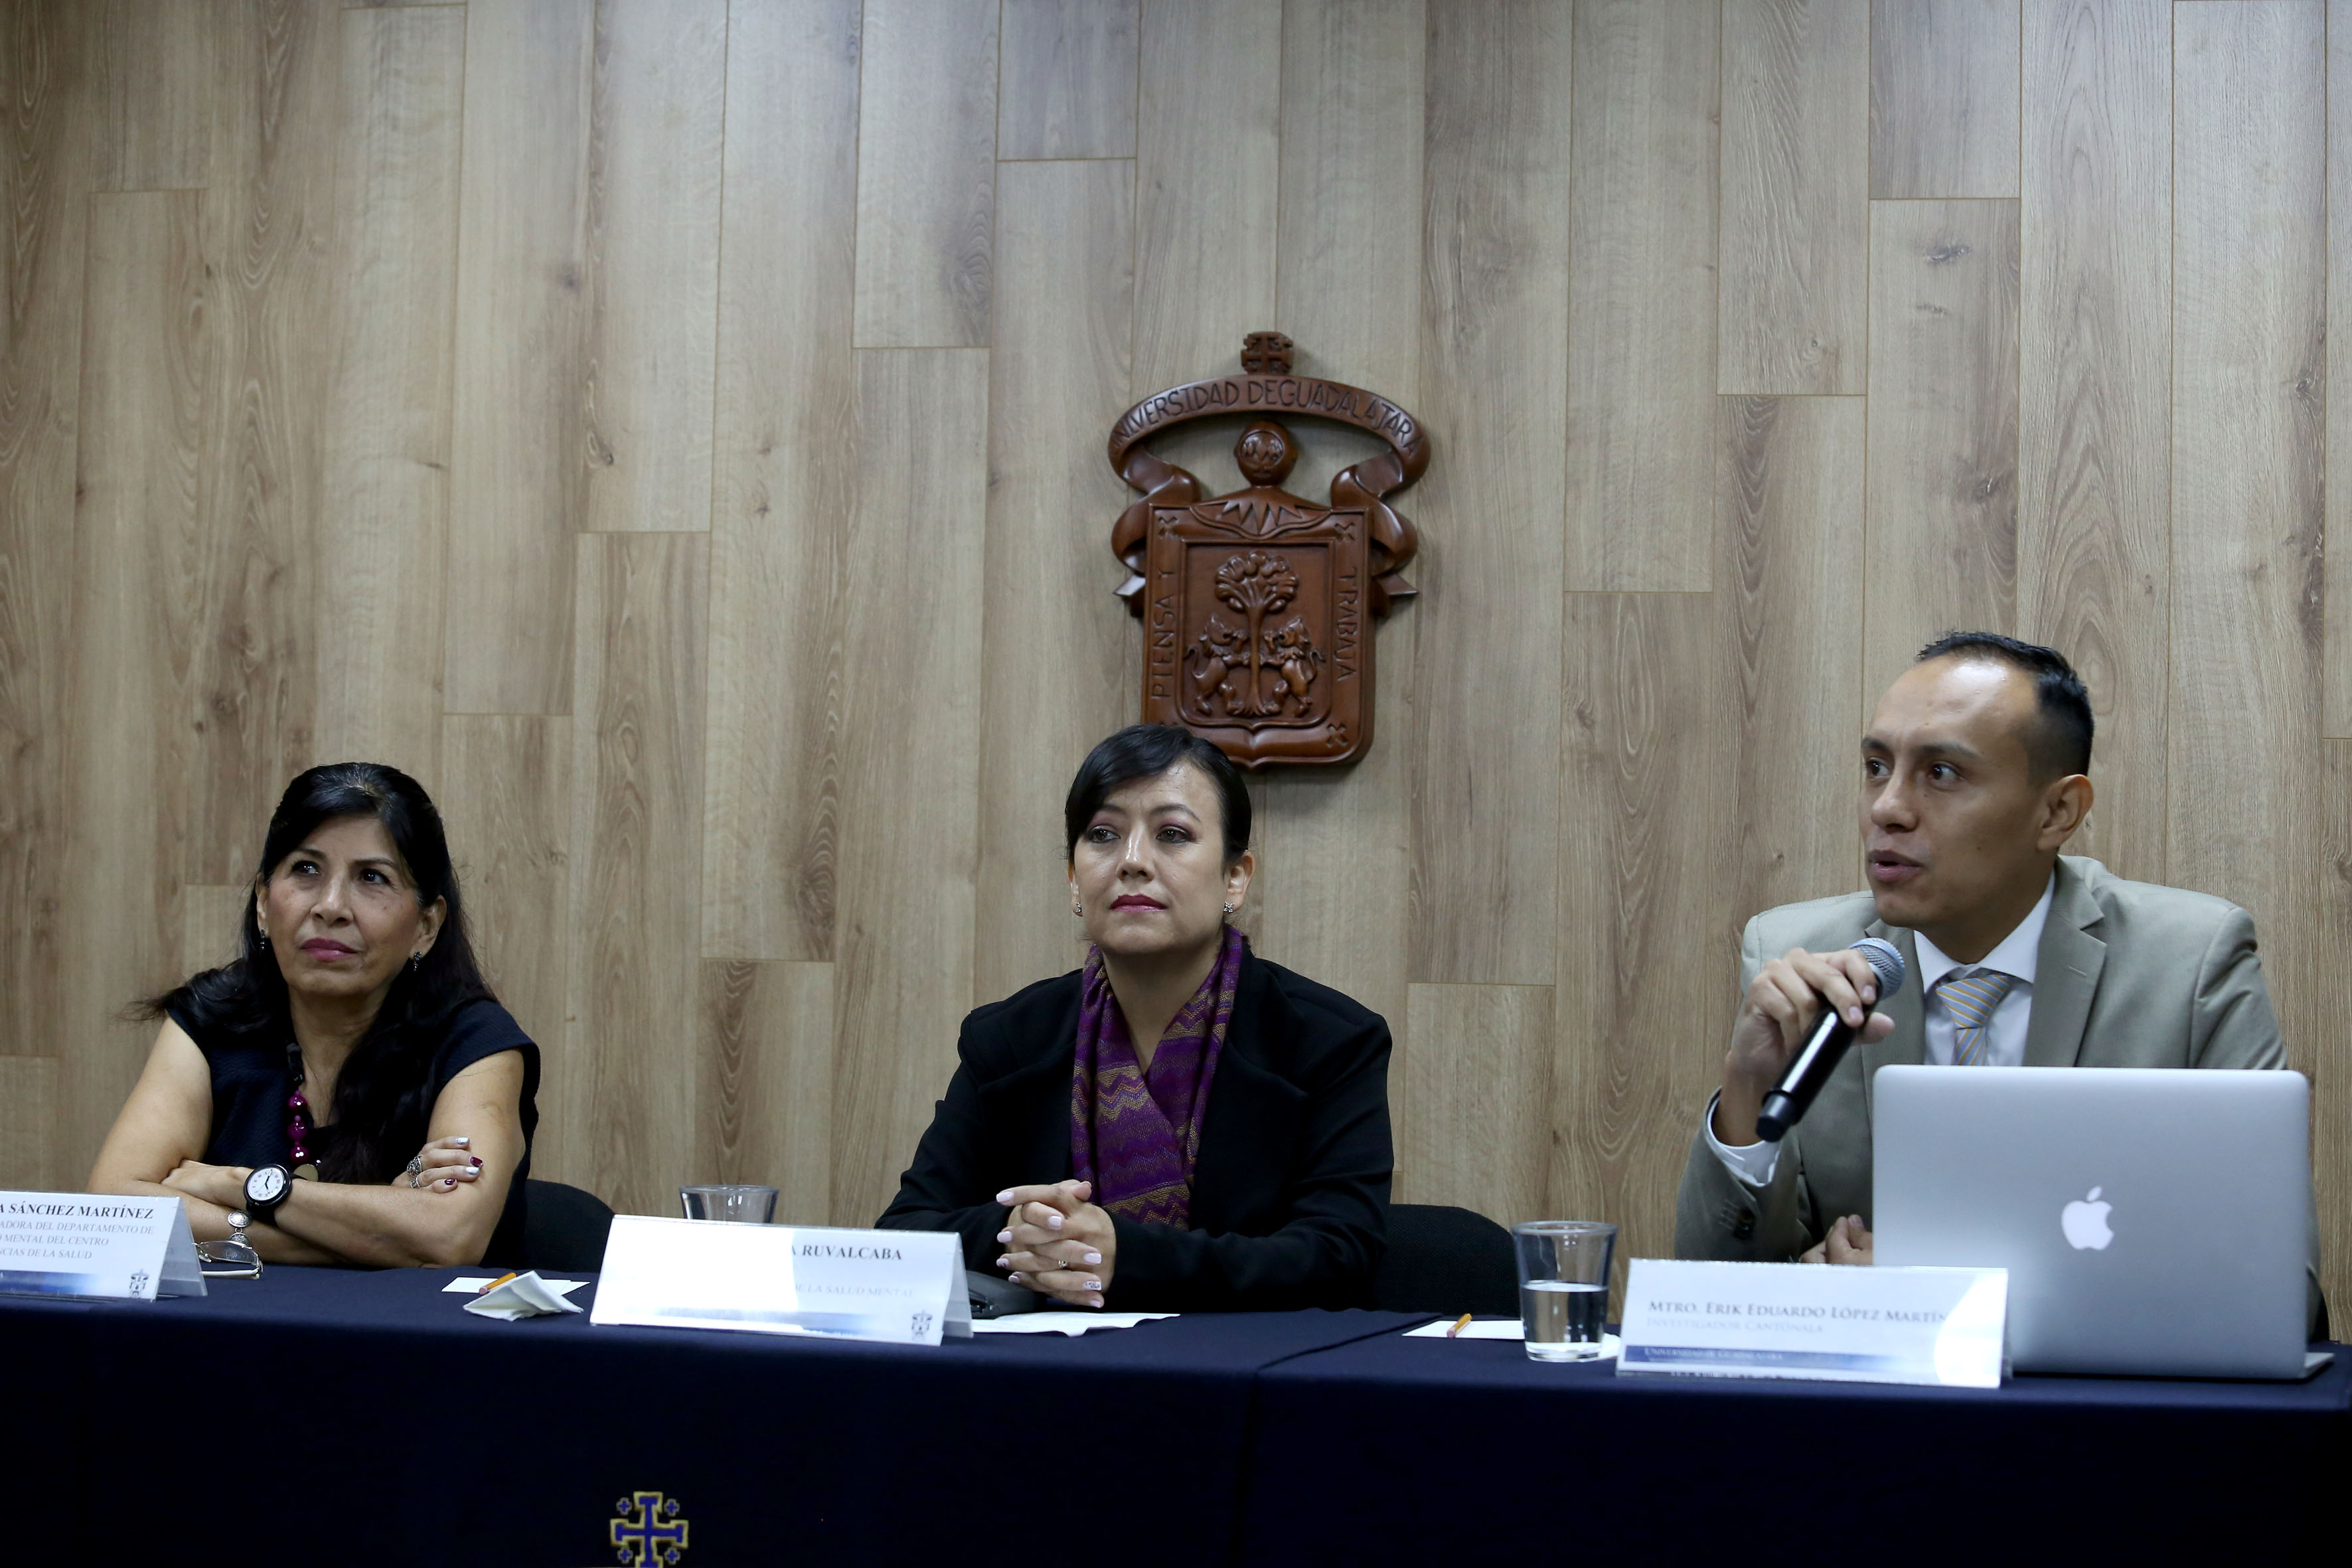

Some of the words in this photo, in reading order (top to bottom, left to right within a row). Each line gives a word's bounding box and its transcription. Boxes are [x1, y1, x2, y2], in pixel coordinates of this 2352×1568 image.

[1112, 381, 1239, 448] NIVERSIDAD
[1333, 566, 1358, 682] TRABAJA
[1151, 595, 1174, 698] PIENSA
[9, 1200, 75, 1216] SÁNCHEZ
[78, 1204, 154, 1219] MARTÍNEZ
[35, 1221, 54, 1230] DEL
[57, 1222, 138, 1233] DEPARTAMENTO
[140, 1225, 154, 1235] DE
[3, 1234, 44, 1243] MENTAL
[46, 1235, 66, 1245] DEL
[68, 1236, 110, 1246] CENTRO
[27, 1249, 40, 1257] DE
[42, 1249, 55, 1258] LA
[58, 1250, 92, 1259] SALUD
[802, 1245, 902, 1261] RUVALCABA
[1648, 1301, 1699, 1314] MTRO.
[1705, 1302, 1742, 1316] ERIK
[1747, 1303, 1826, 1318] EDUARDO
[1831, 1305, 1881, 1321] LÓPEZ
[1647, 1317, 1741, 1330] INVESTIGADOR
